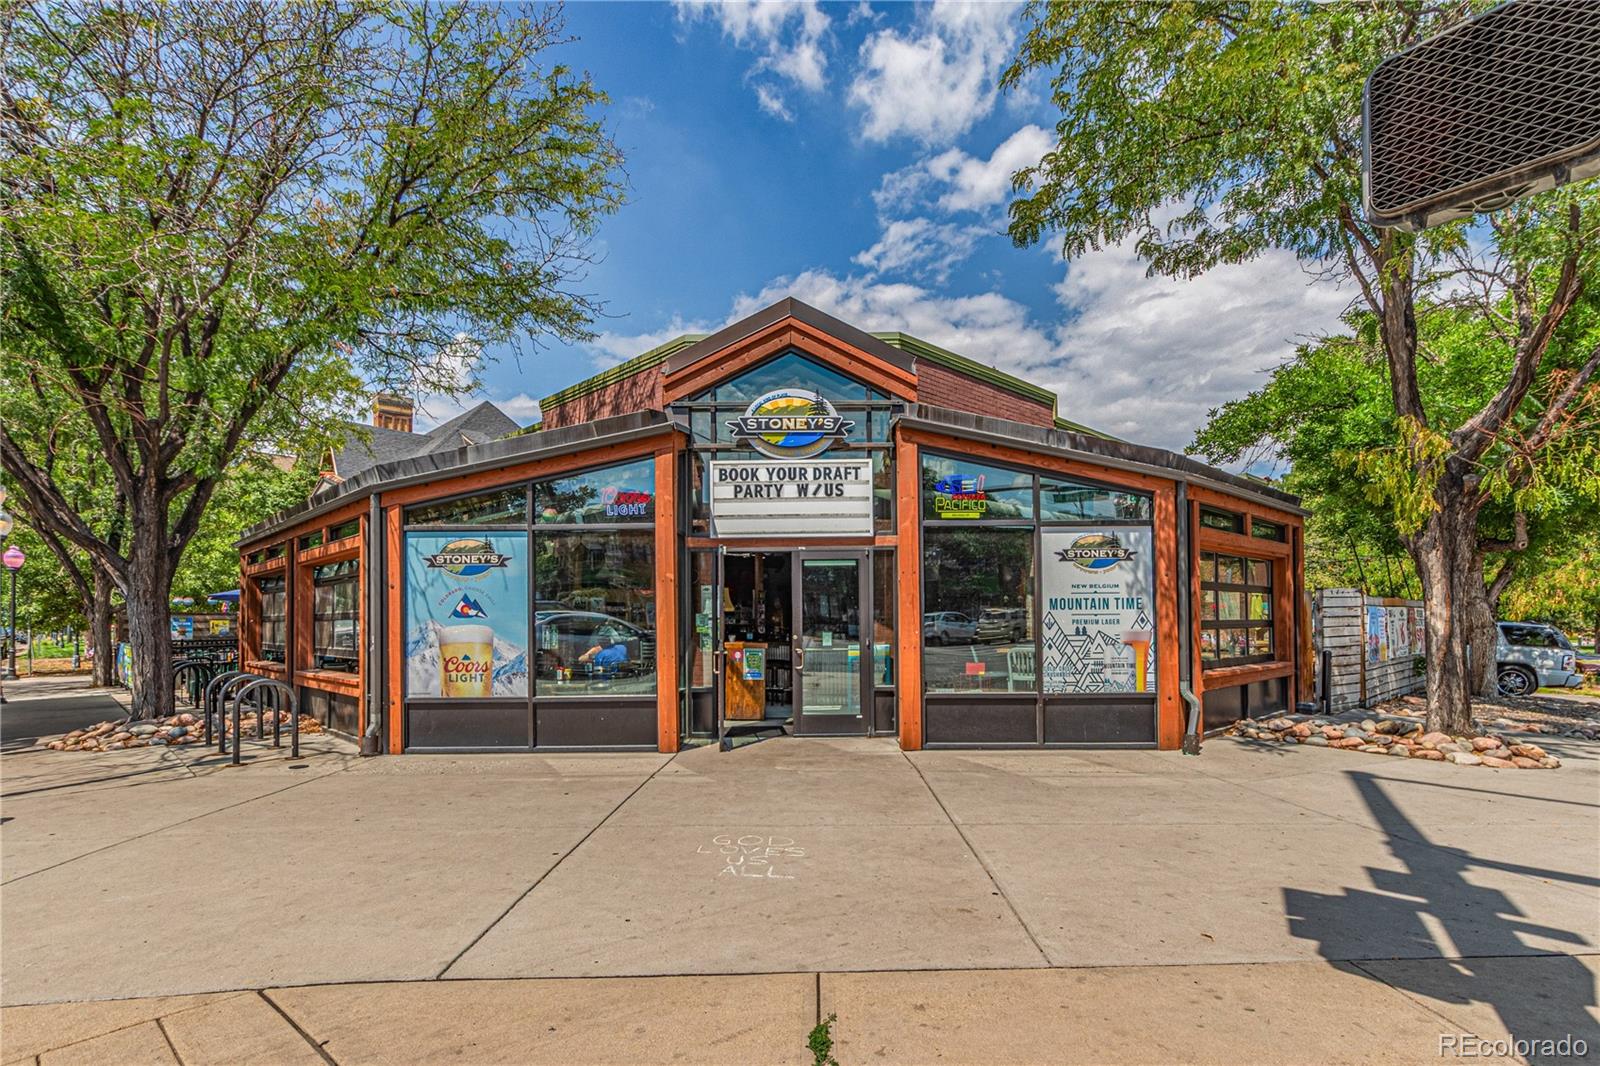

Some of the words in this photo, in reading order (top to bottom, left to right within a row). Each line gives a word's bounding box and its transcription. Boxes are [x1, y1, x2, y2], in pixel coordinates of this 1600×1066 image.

[746, 417, 834, 430] STONEY'S
[718, 467, 760, 482] BOOK
[766, 467, 808, 481] YOUR
[812, 466, 861, 481] DRAFT
[734, 484, 784, 498] PARTY
[606, 503, 646, 516] LIGHT
[436, 555, 499, 564] STONEY'S
[1068, 550, 1125, 558] STONEY'S
[1050, 597, 1110, 611] MOUNTAIN
[1114, 597, 1143, 610] TIME
[443, 656, 490, 673] Coors
[448, 673, 484, 682] LIGHT
[712, 835, 794, 846] GOD
[697, 845, 805, 856] LOVES
[726, 855, 768, 865] US
[718, 865, 795, 879] ALL
